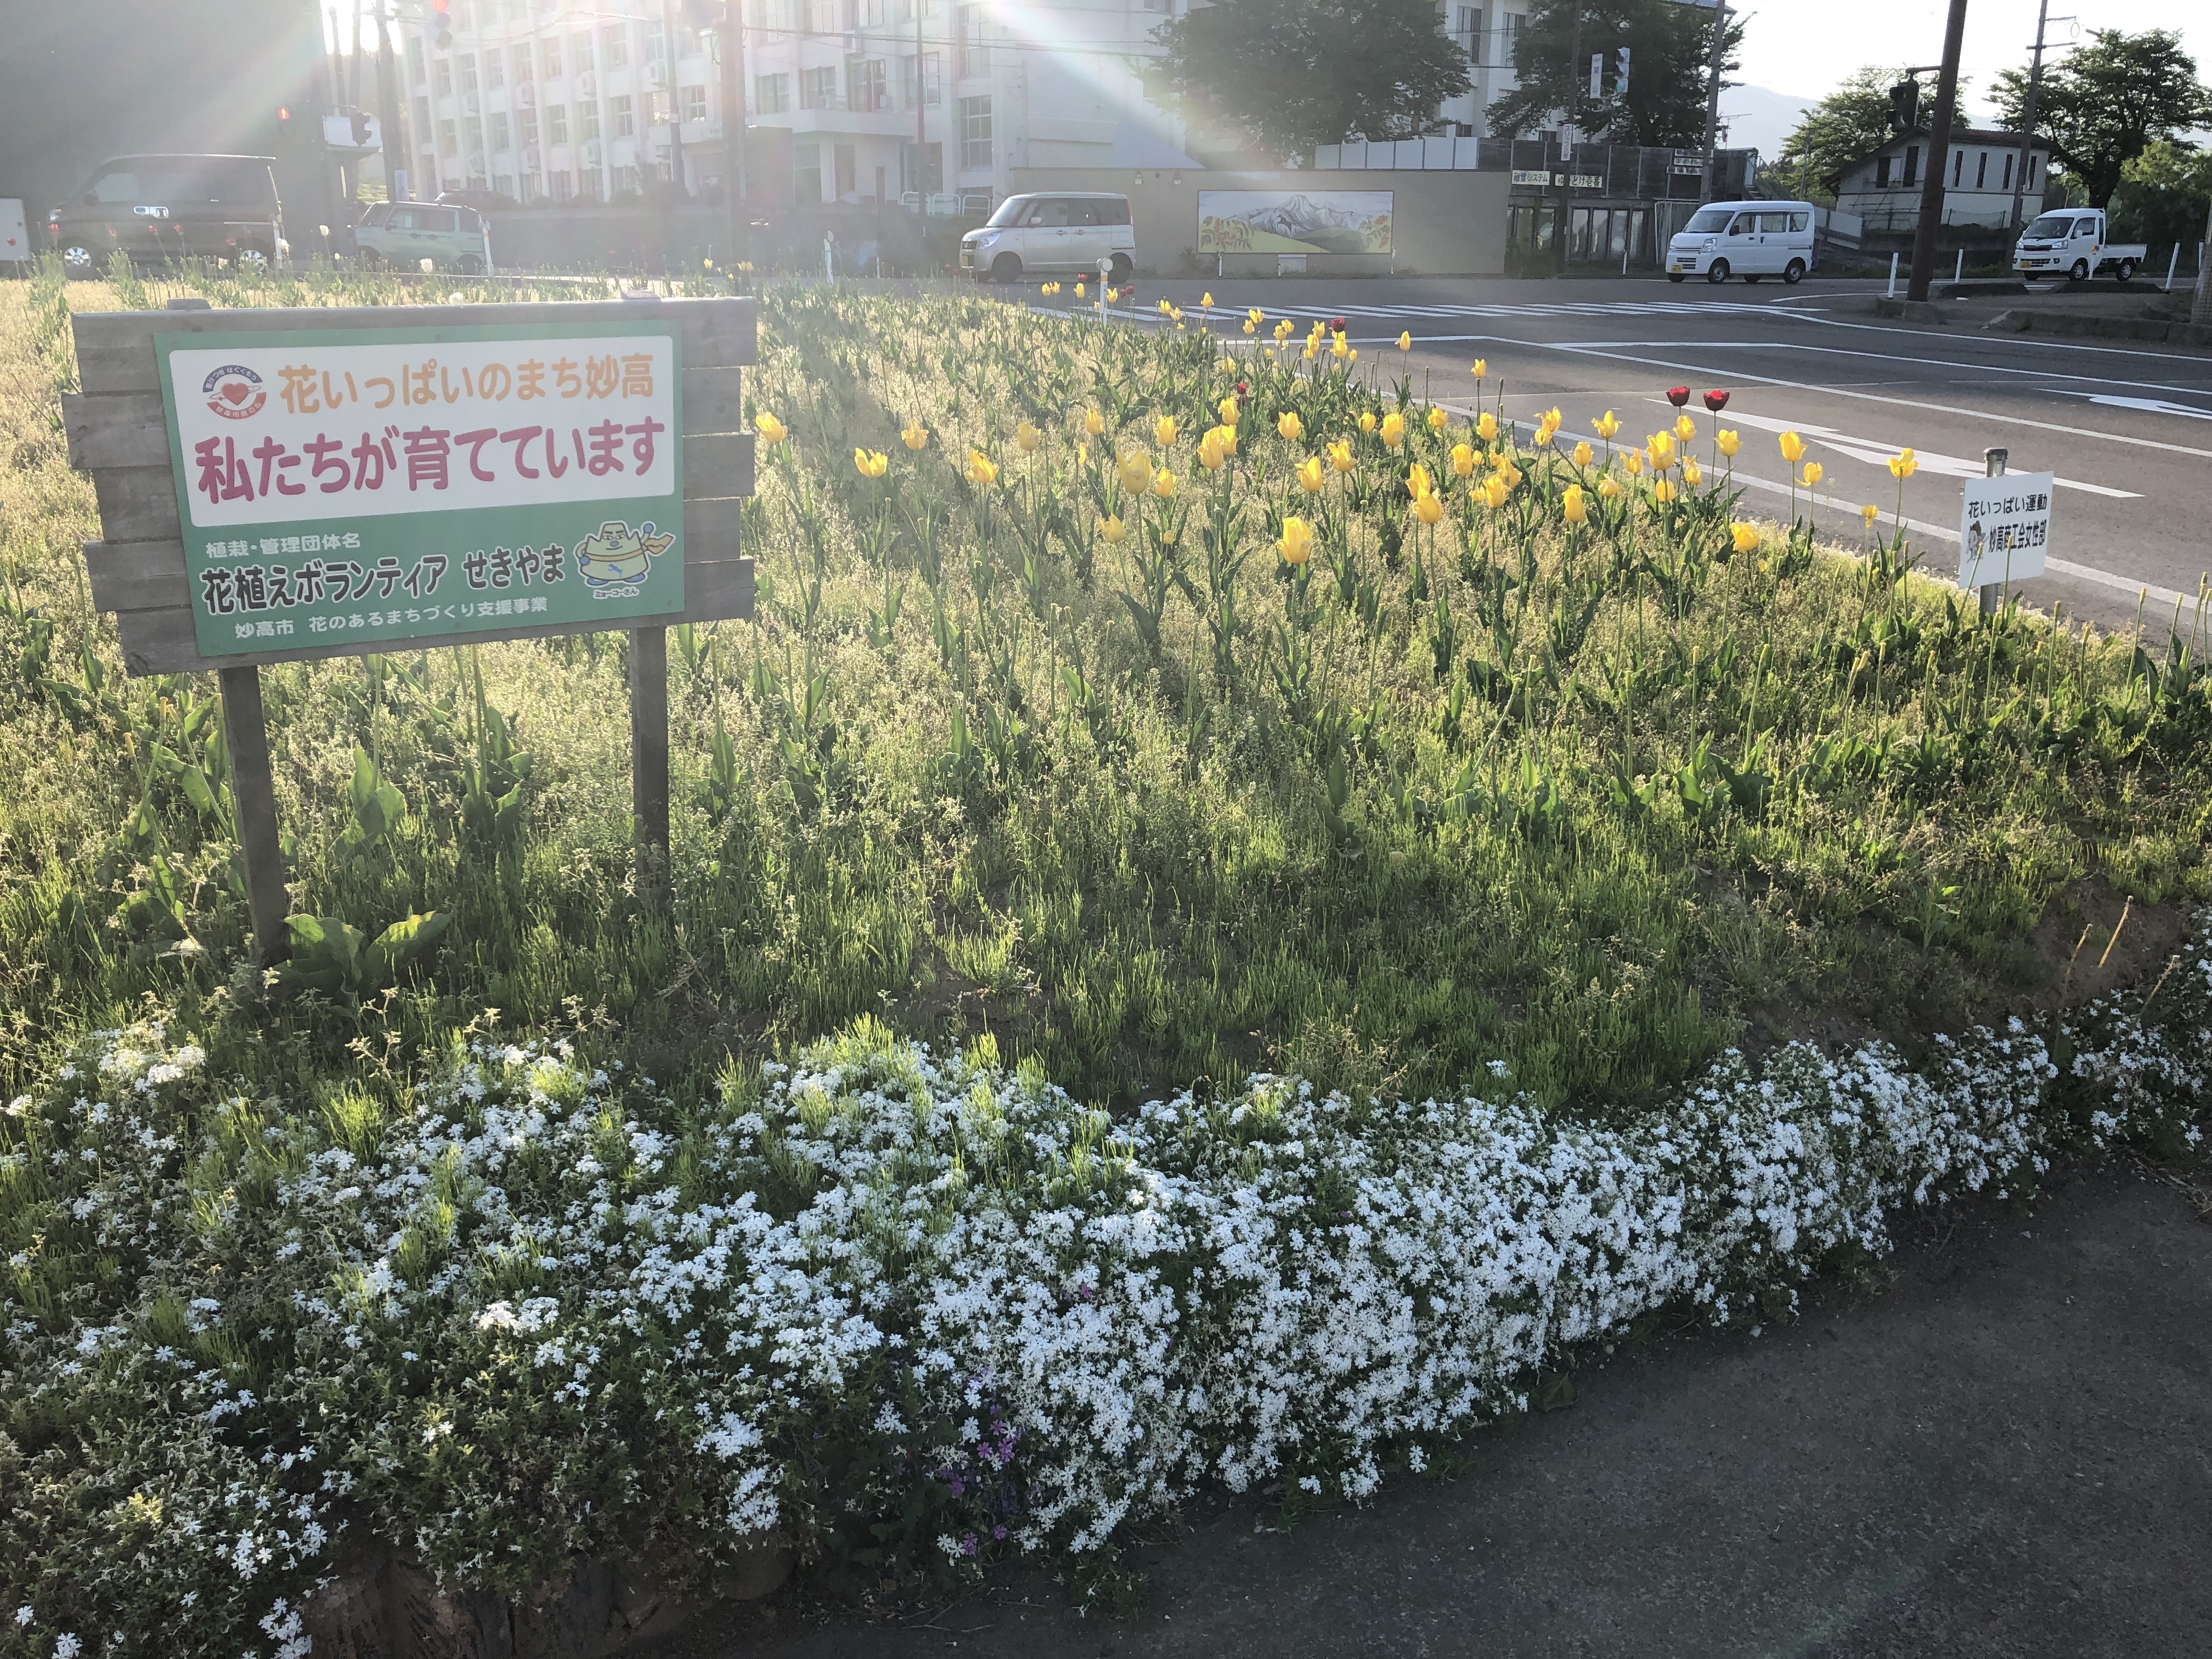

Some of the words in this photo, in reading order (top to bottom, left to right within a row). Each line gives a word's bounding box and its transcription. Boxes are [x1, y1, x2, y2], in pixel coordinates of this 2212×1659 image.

[278, 352, 653, 414] 花いっぱいのまち妙高
[195, 416, 665, 504] 私たちが育てています
[1968, 493, 2048, 519] 花いっぱい運動
[205, 533, 362, 558] 植栽・管理団体名
[200, 555, 448, 615] 花植えボランティア
[462, 543, 565, 590] せきやま
[235, 619, 295, 639] 妙高市
[308, 596, 548, 633] 花のあるまちづくり支援事業
